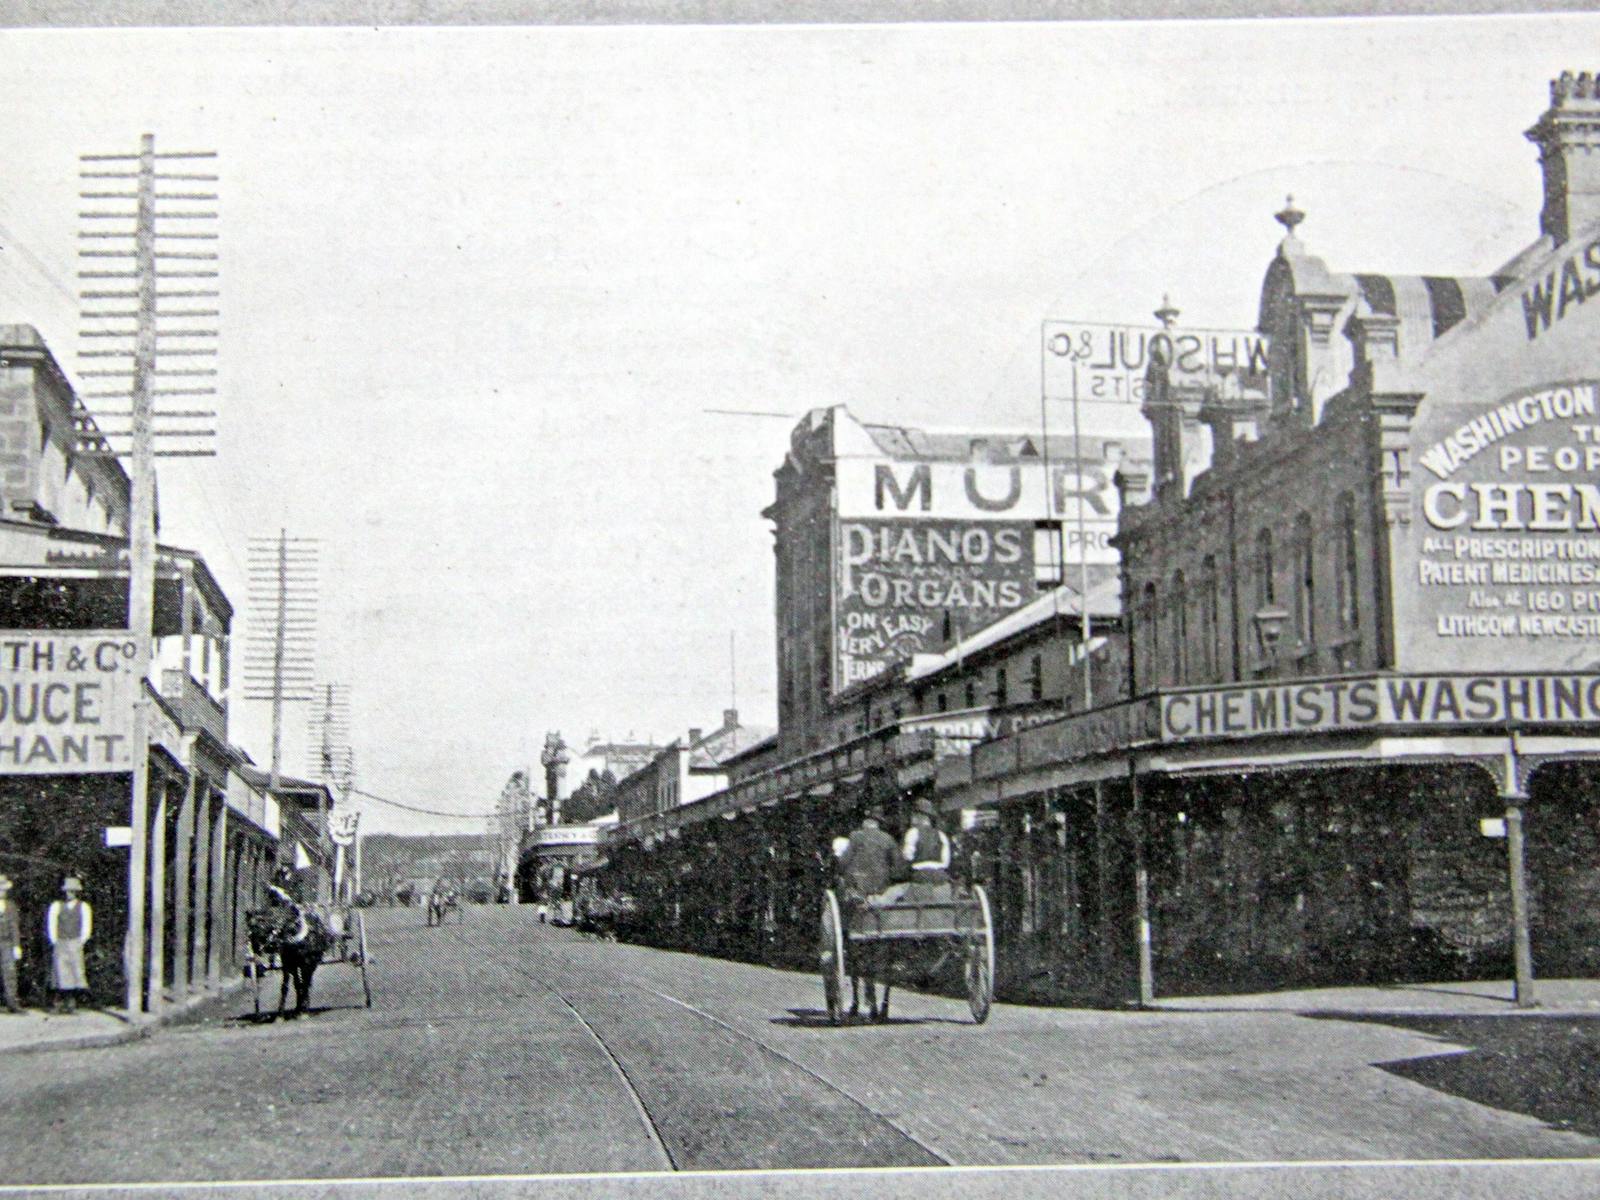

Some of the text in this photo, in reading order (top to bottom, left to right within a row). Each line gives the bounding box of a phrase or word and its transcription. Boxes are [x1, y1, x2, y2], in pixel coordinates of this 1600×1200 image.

[1419, 385, 1595, 479] WASHINGTON
[840, 523, 1022, 599] PIANOS
[1420, 560, 1594, 584] PATENT MEDICINES
[859, 572, 1022, 607] ORGANS
[1527, 591, 1566, 612] 160
[846, 611, 878, 629] ON
[881, 613, 934, 639] EASY
[66, 646, 87, 671] &
[1164, 681, 1379, 737] CHEMISTS
